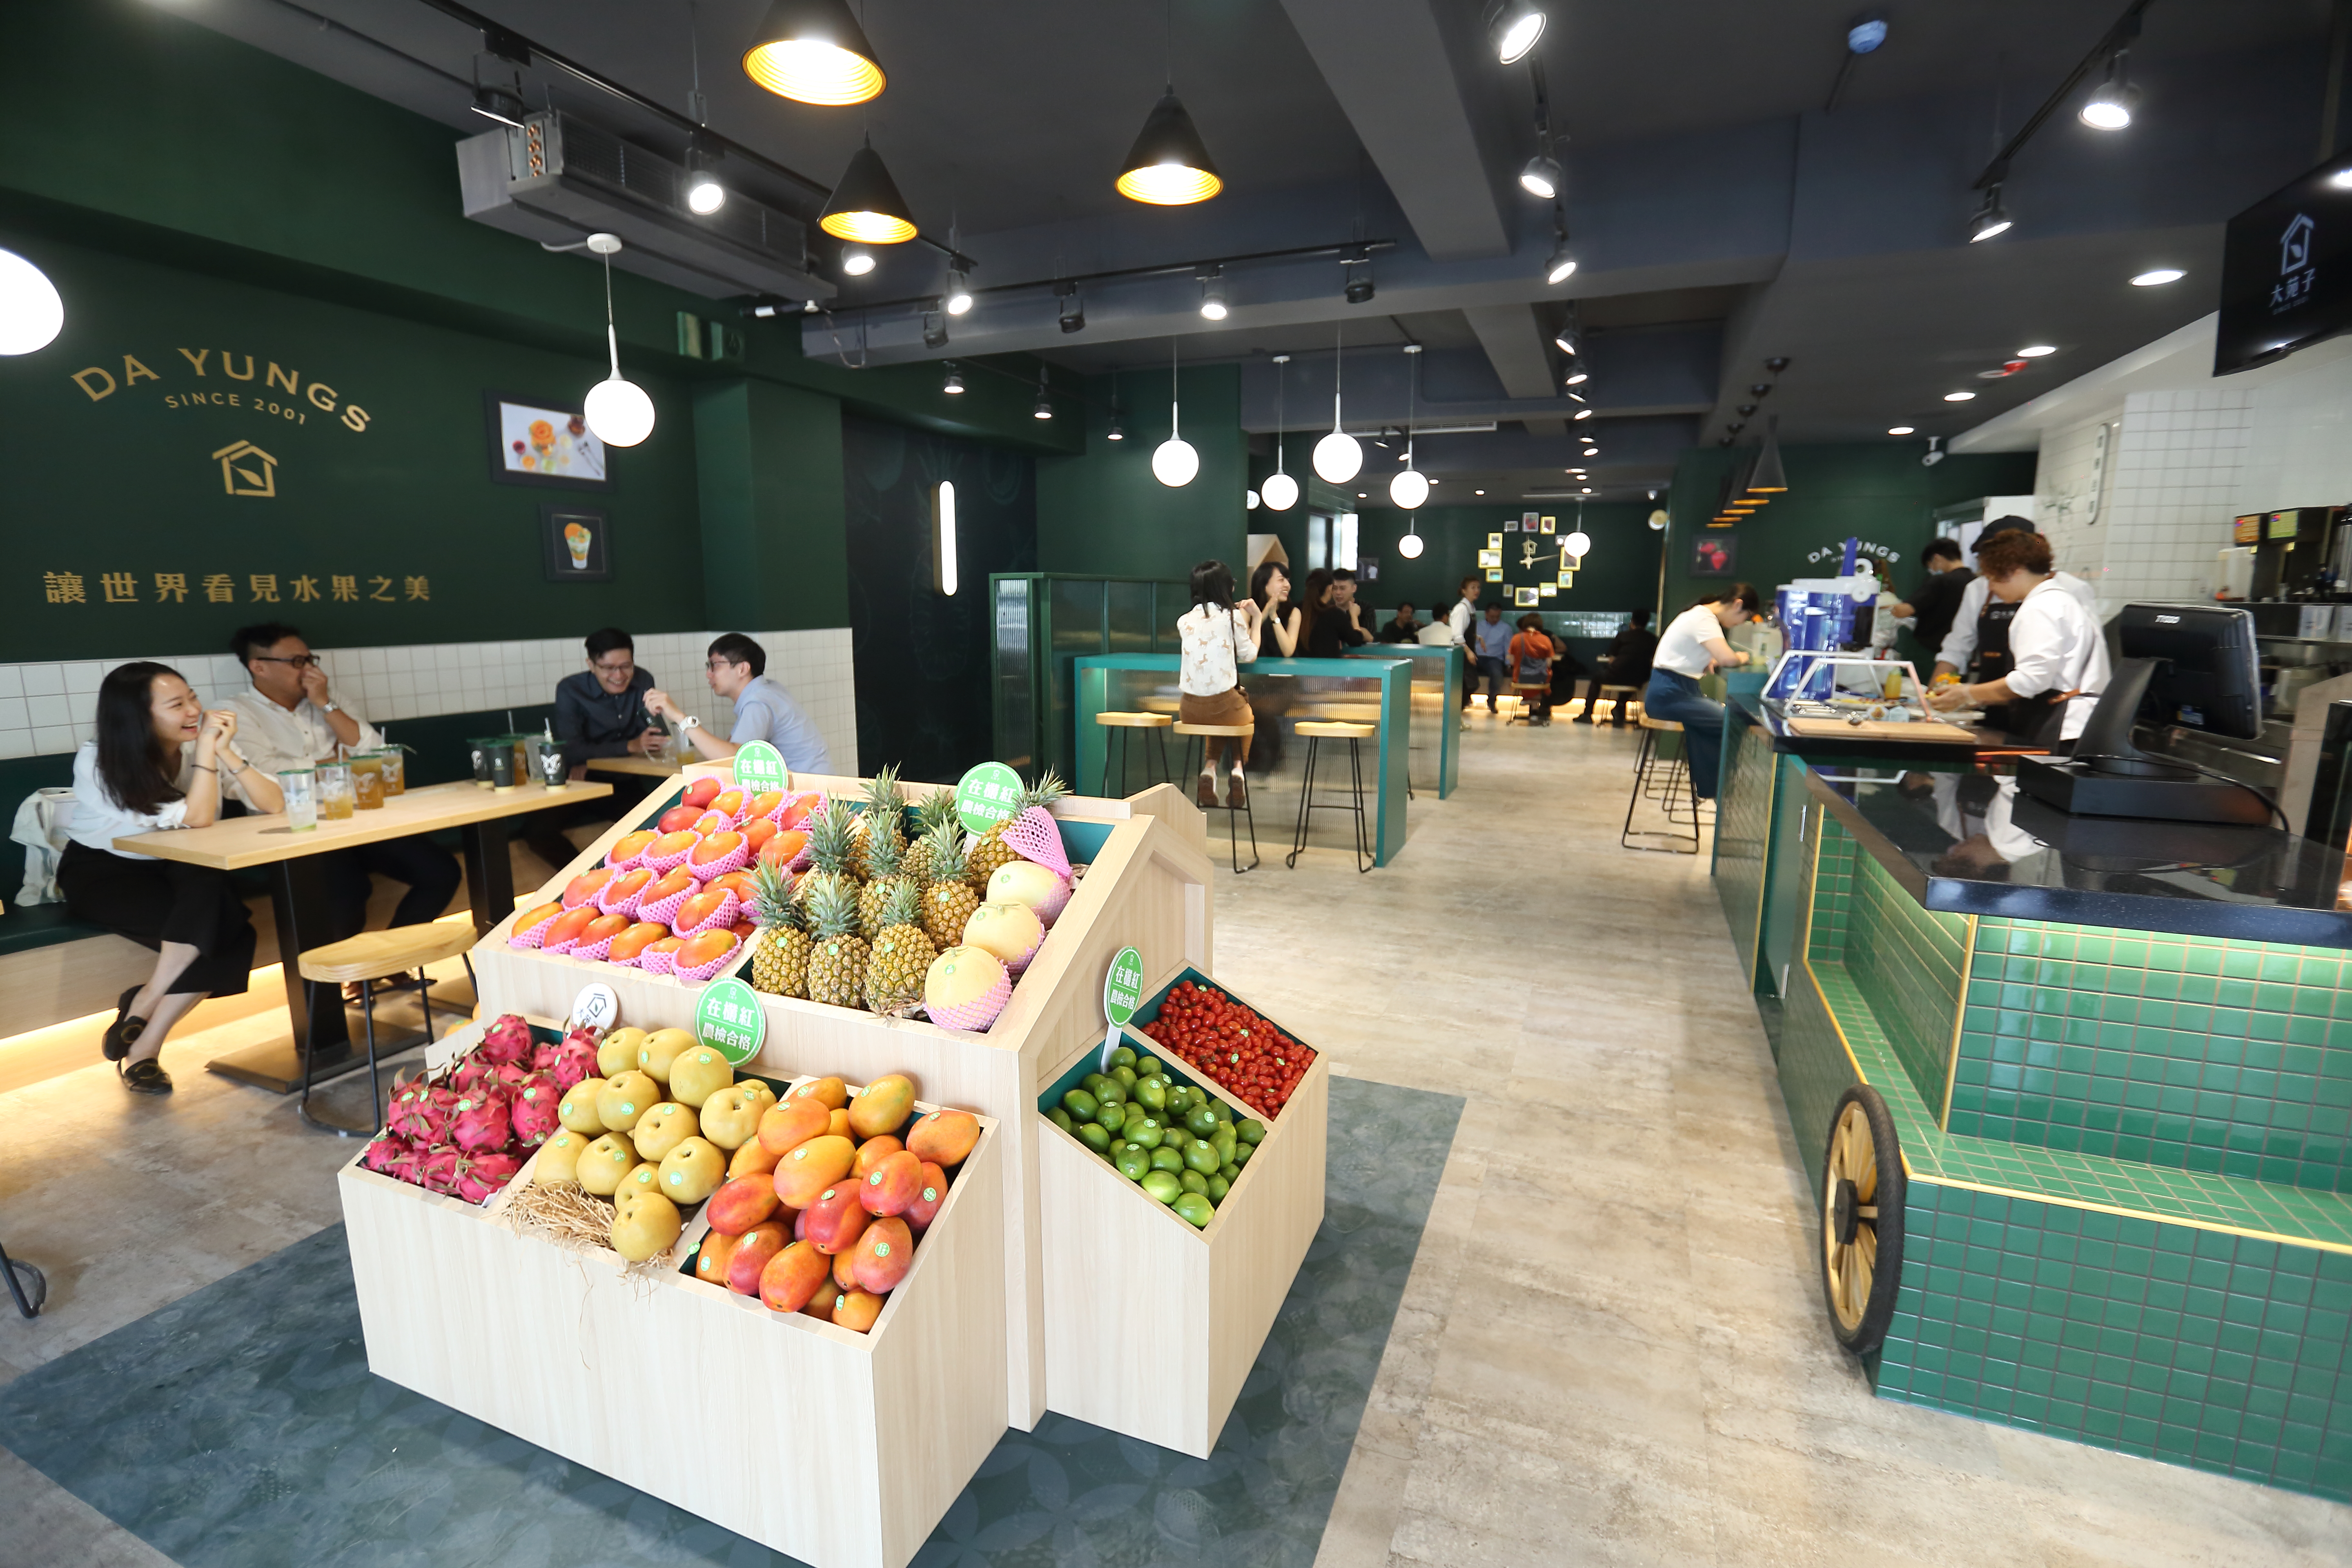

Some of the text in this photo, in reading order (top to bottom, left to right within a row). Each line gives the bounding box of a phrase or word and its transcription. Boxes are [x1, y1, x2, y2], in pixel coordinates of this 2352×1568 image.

[71, 348, 371, 433] DA YUNGS
[165, 392, 305, 425] SINCE 2001
[1807, 546, 1833, 564] DA
[43, 571, 430, 604] 讓世界看見水果之美
[960, 799, 1010, 821] 農檢合格
[1110, 989, 1136, 1010] 農檢合格
[702, 1022, 751, 1051] 農檢合格
